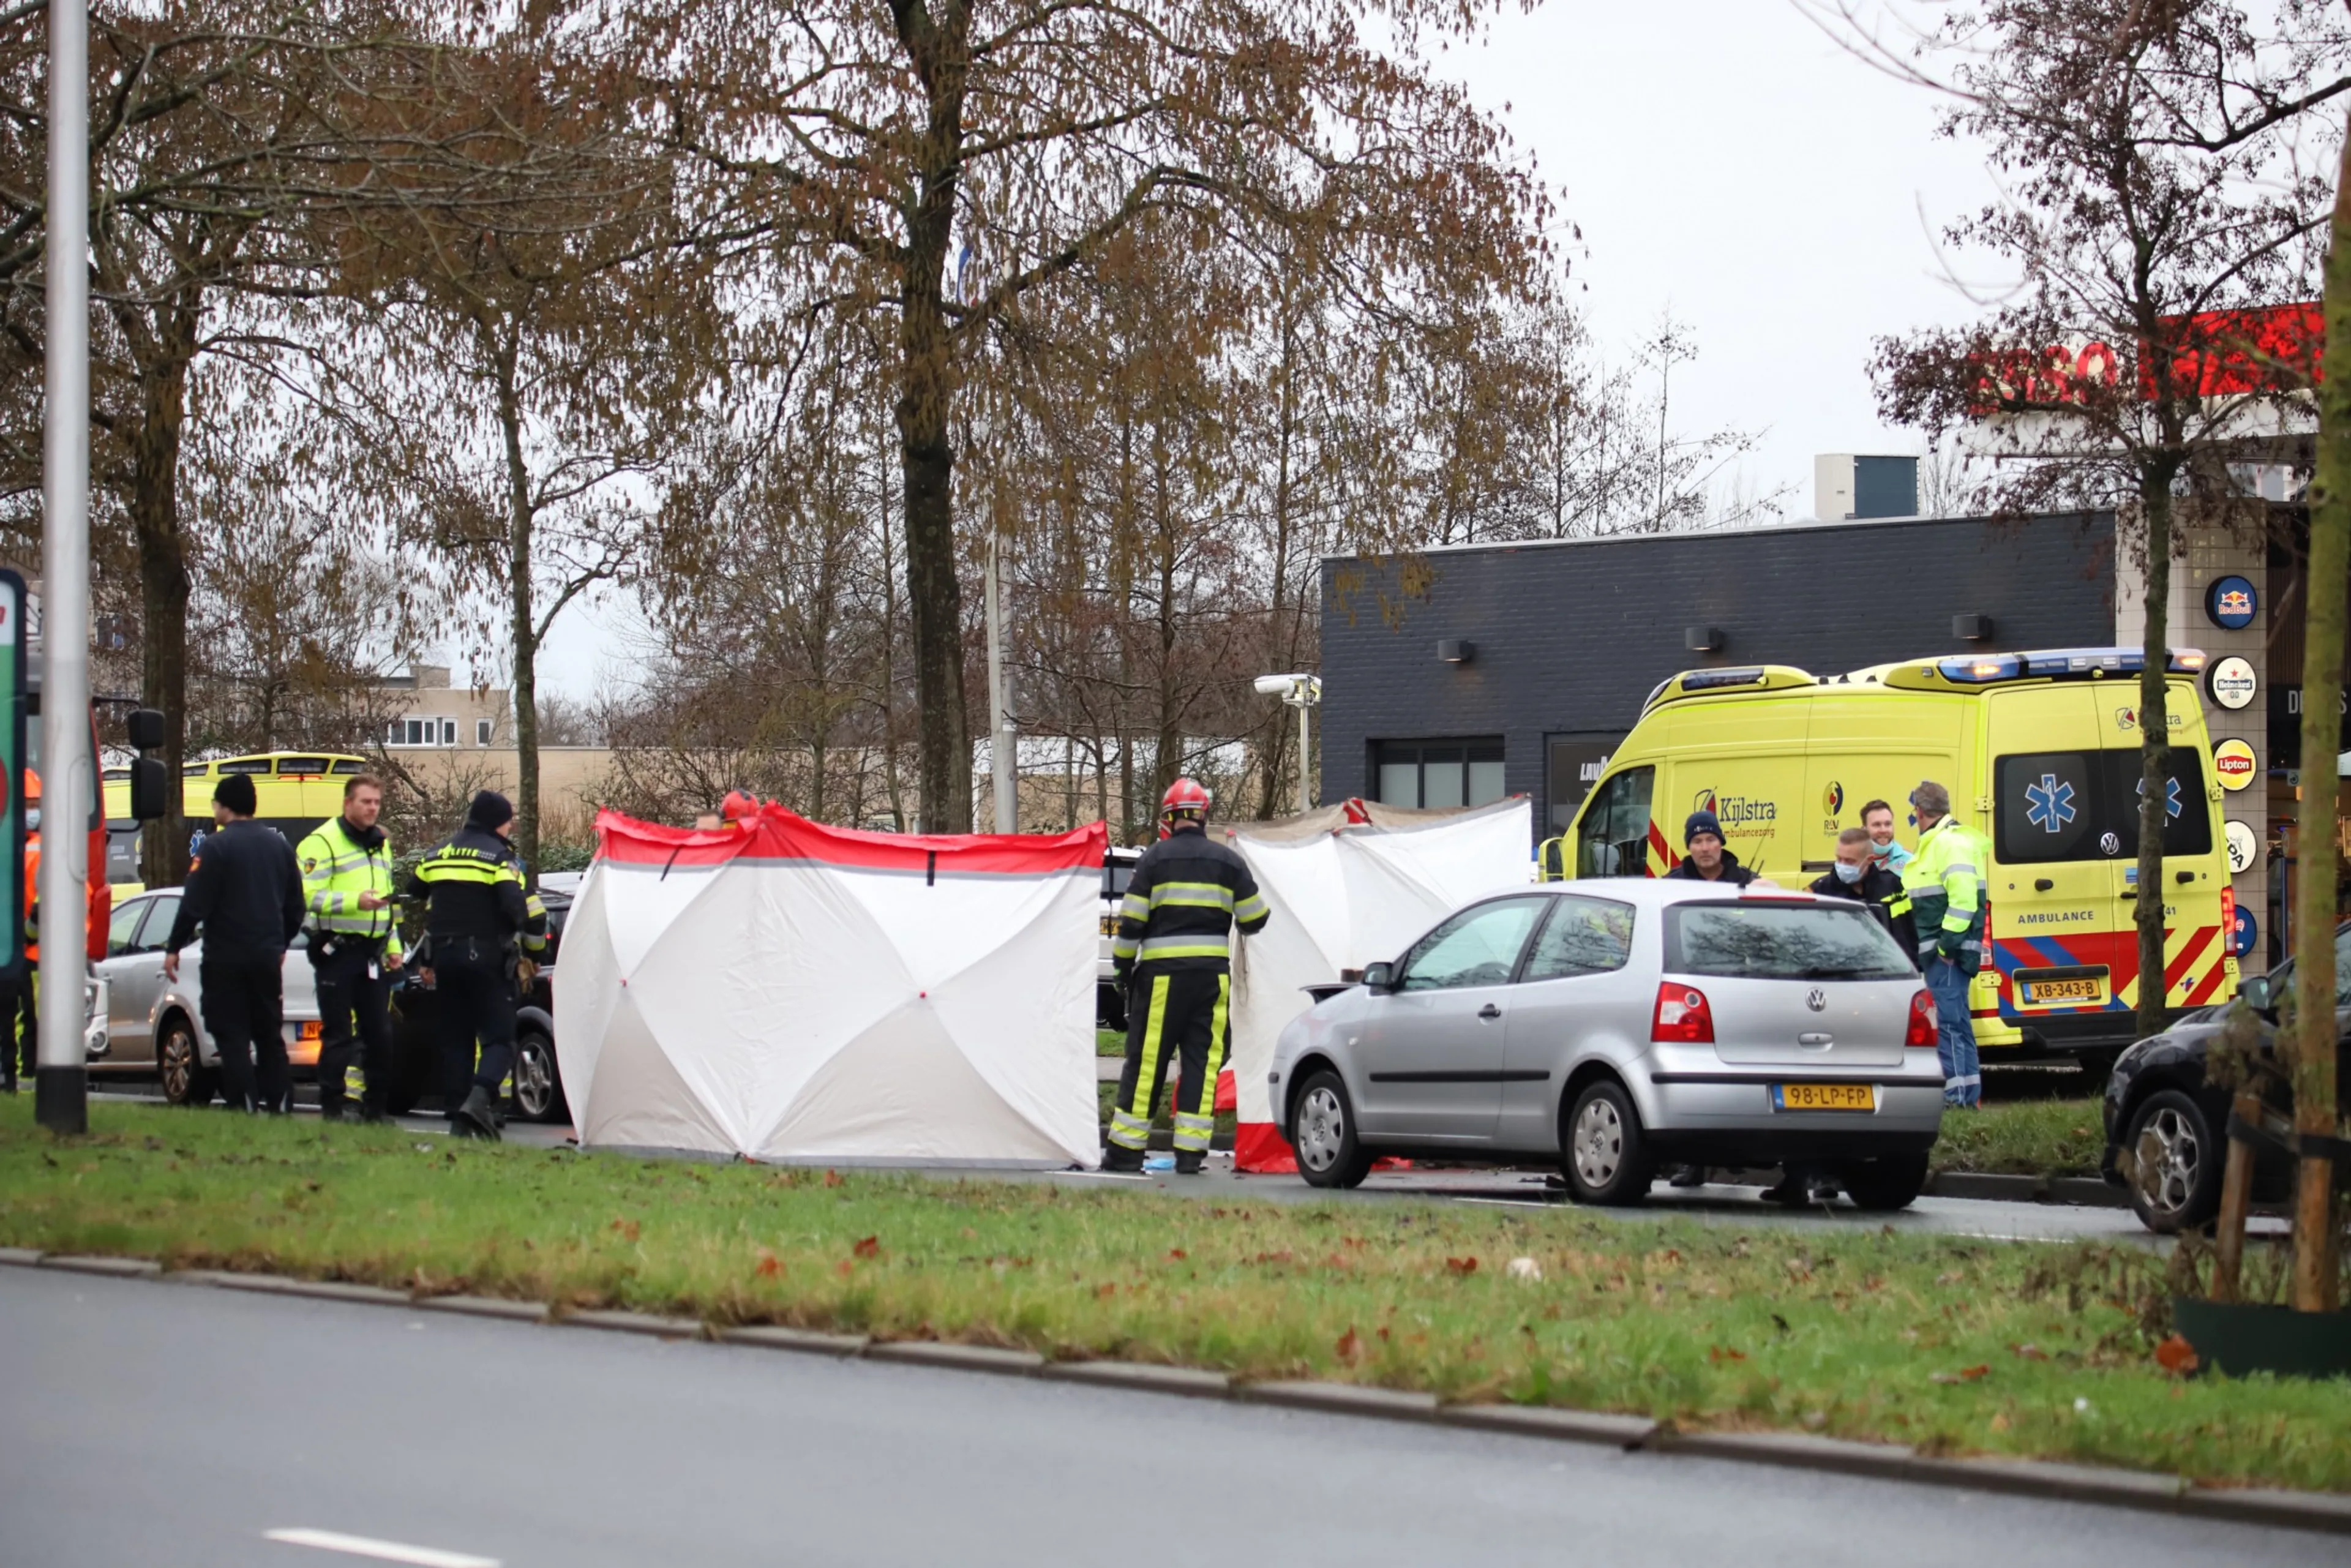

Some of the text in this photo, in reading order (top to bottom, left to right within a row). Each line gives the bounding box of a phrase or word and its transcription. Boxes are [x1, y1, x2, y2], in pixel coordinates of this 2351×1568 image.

[2218, 680, 2251, 689] Heineken
[2219, 759, 2249, 771] Lipton
[1720, 797, 1775, 827] Kijlstra
[1723, 828, 1775, 838] mbulancezorg
[2018, 910, 2094, 924] AMBULANCE
[2034, 981, 2094, 997] XB-343-B
[1790, 1087, 1865, 1105] 98-LP-FP
